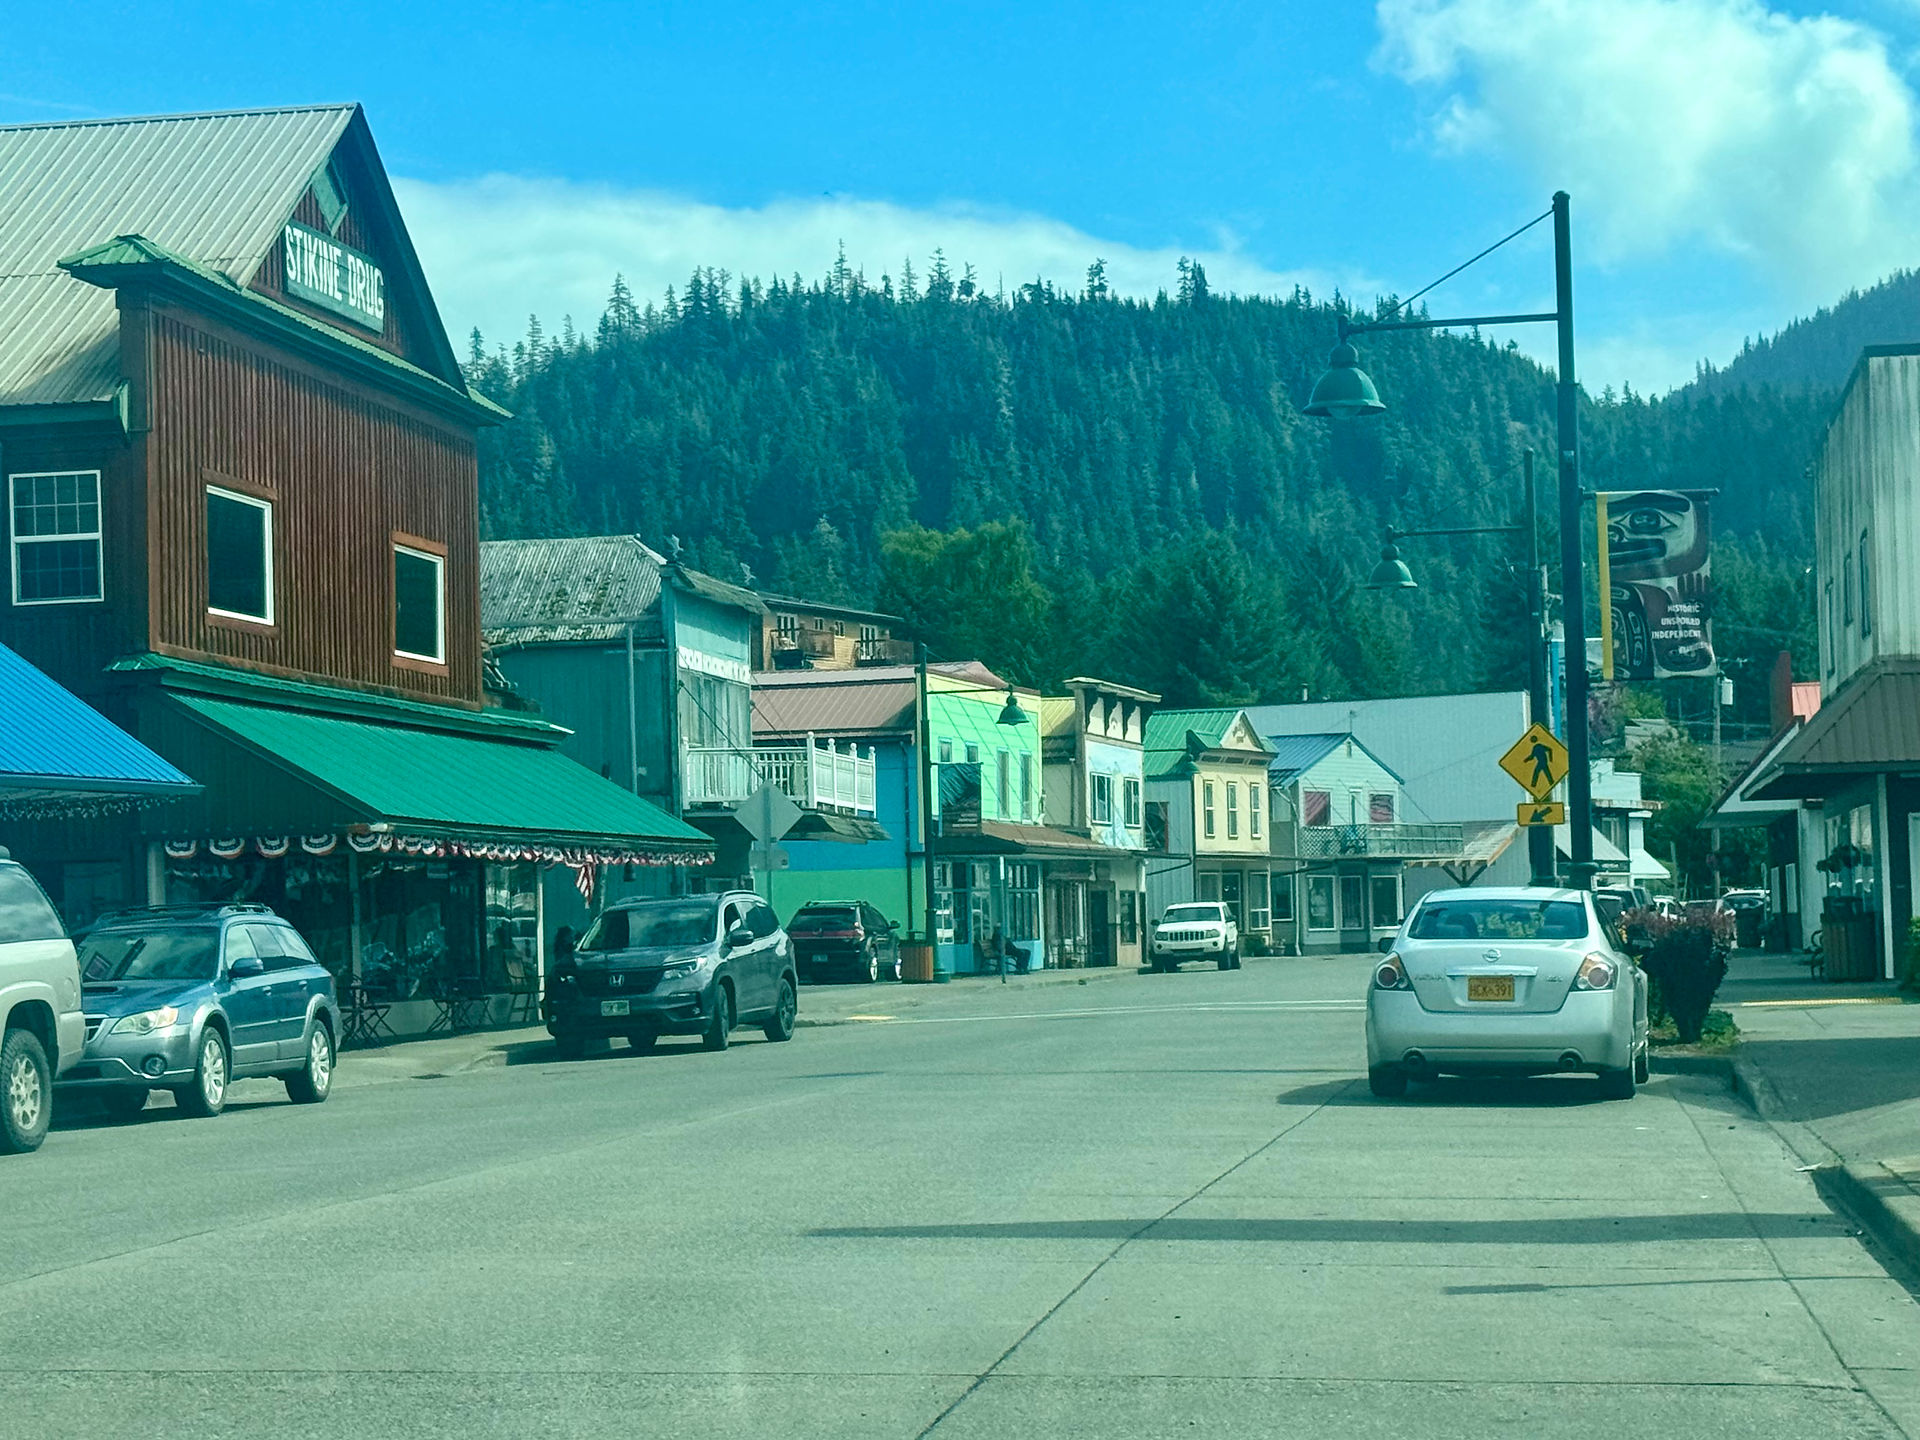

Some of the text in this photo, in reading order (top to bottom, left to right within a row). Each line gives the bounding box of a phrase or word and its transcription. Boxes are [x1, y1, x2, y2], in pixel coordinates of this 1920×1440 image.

[285, 224, 384, 319] STIKINE DRUG
[1667, 604, 1700, 613] HISTORIC
[1661, 617, 1701, 626] UNSPOILED
[1651, 630, 1701, 639] INDEPENDENT
